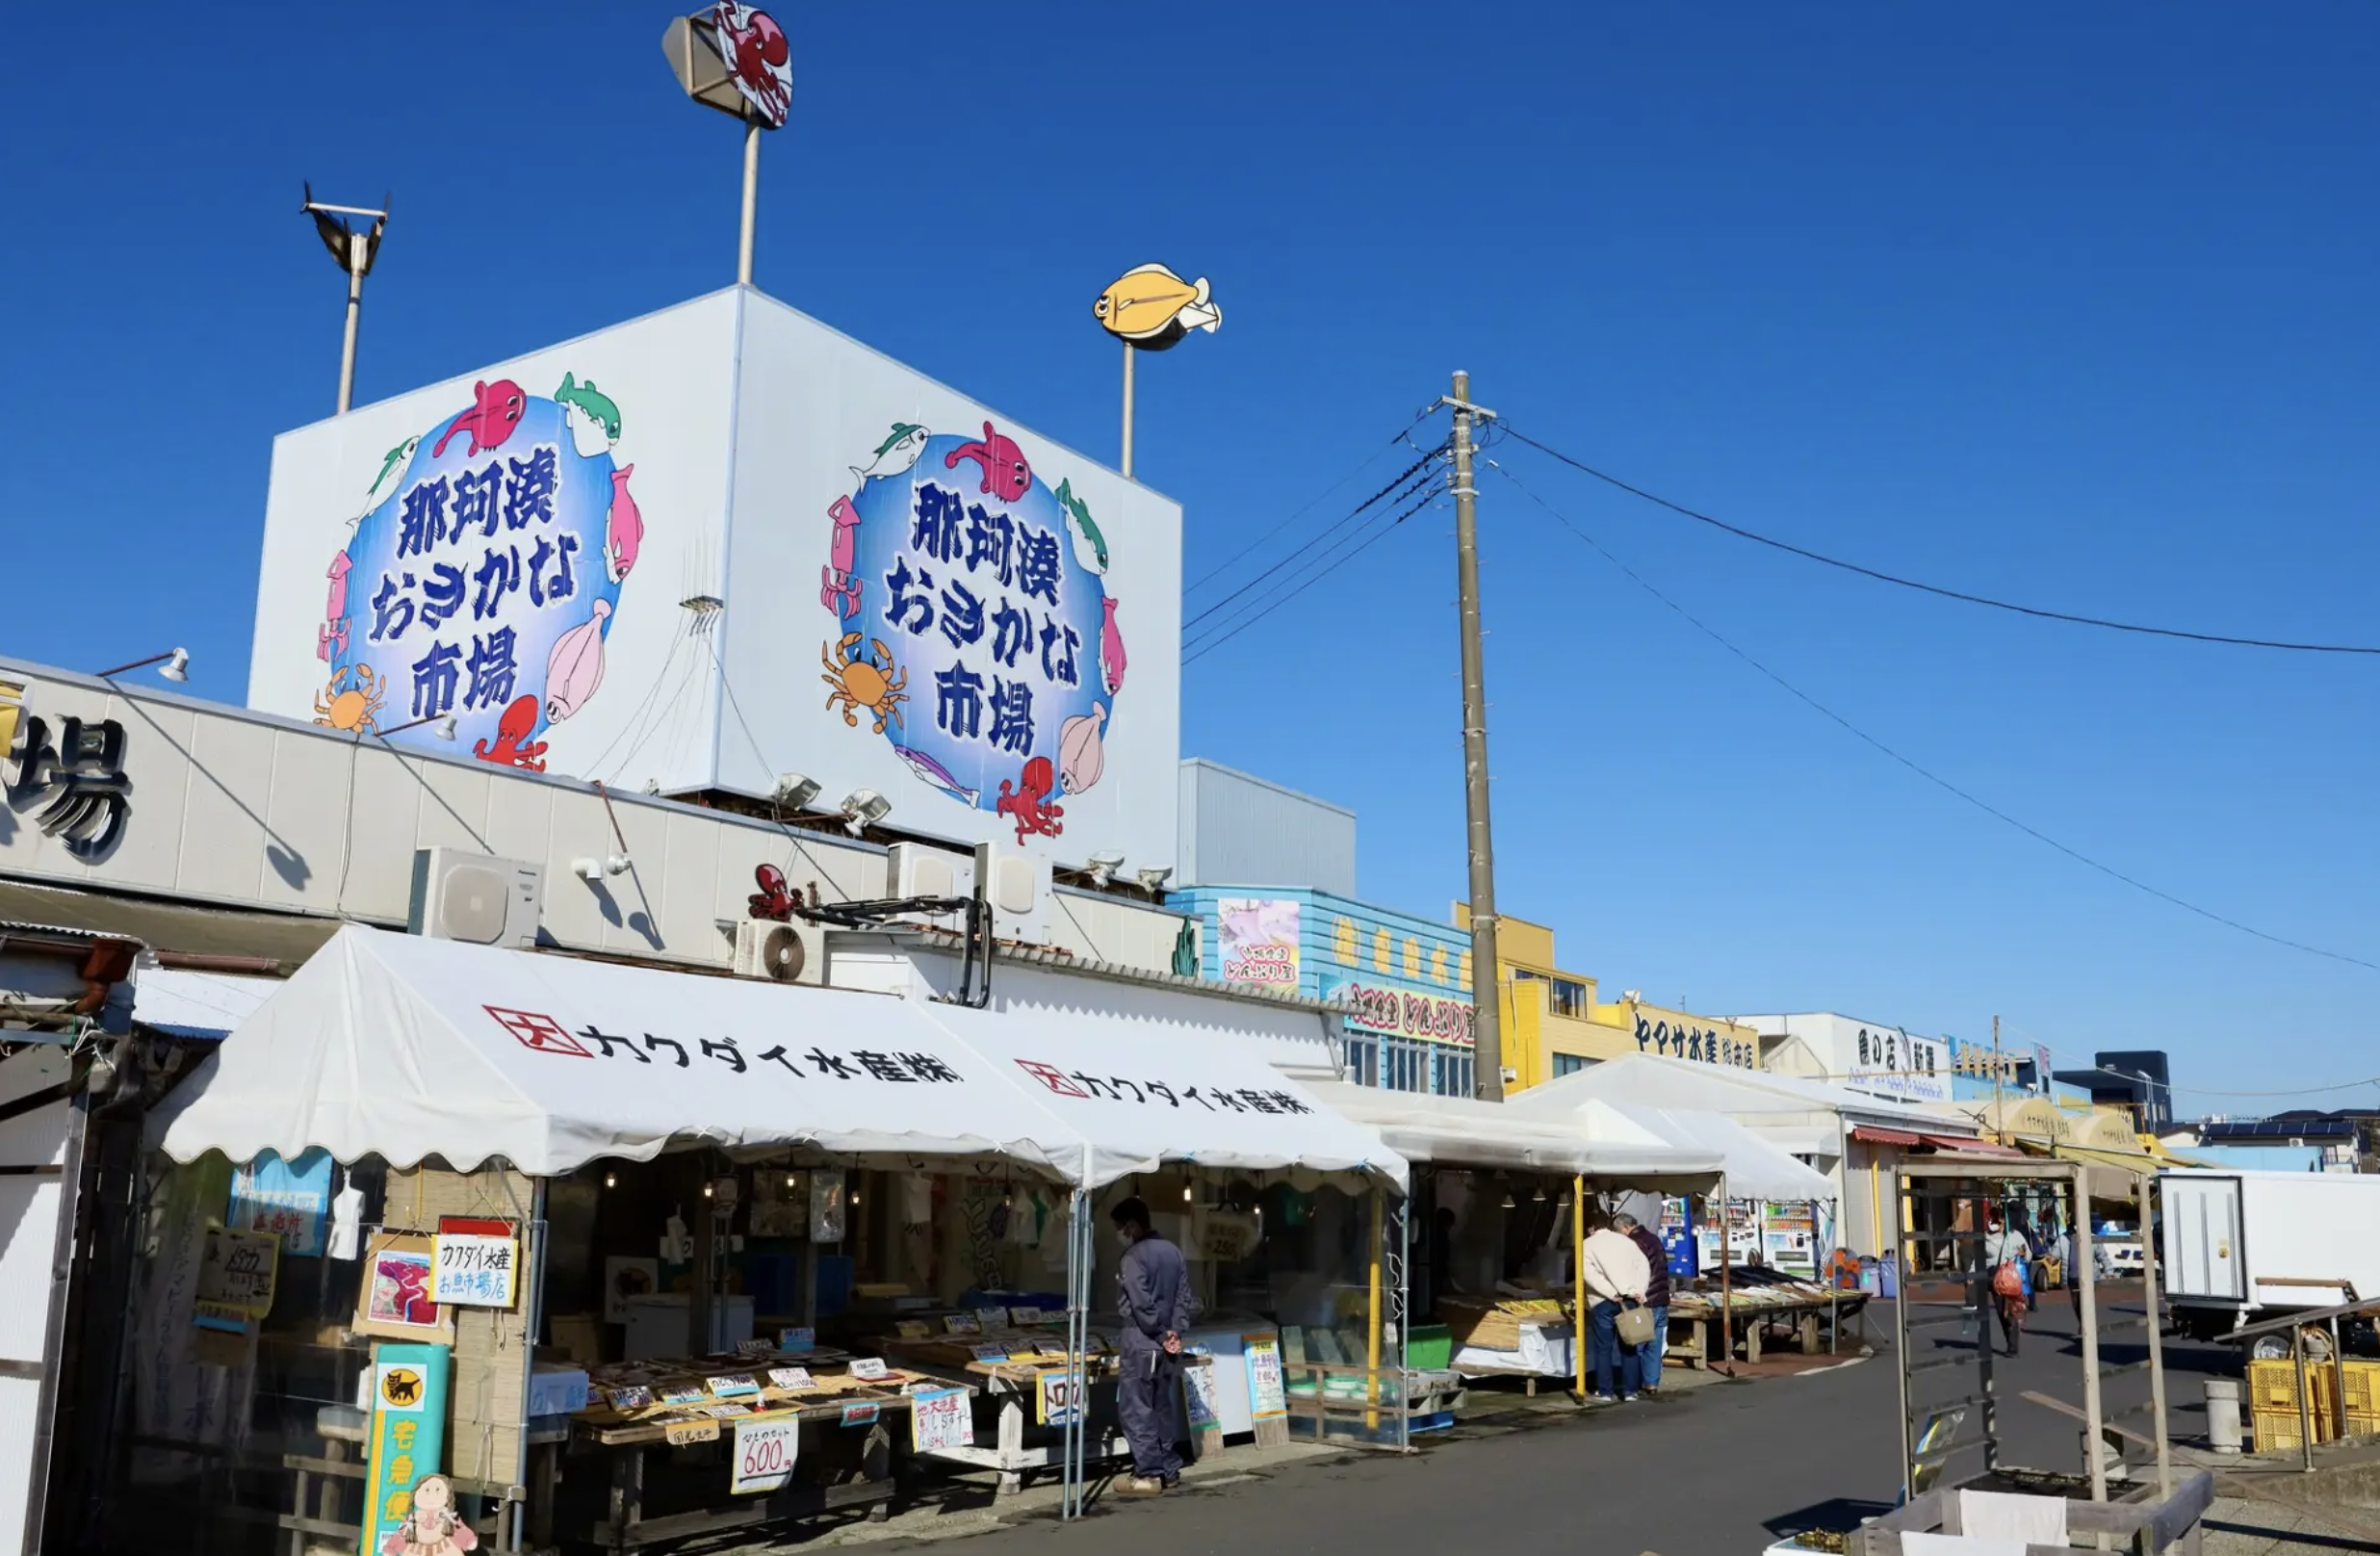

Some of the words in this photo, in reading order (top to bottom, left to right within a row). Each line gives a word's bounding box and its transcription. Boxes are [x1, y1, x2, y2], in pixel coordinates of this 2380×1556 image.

[397, 448, 558, 559] 那珂湊
[913, 483, 1061, 606] 那珂湊
[370, 535, 579, 642] おさかな
[886, 558, 1080, 686] おさかな
[411, 625, 517, 718] 市場
[935, 661, 1034, 756] 市場
[1635, 1012, 1718, 1064] ヤマサ水産
[439, 1271, 505, 1300] お魚市場店
[442, 1244, 510, 1269] カクダイ水産
[385, 1420, 417, 1520] 宅急便
